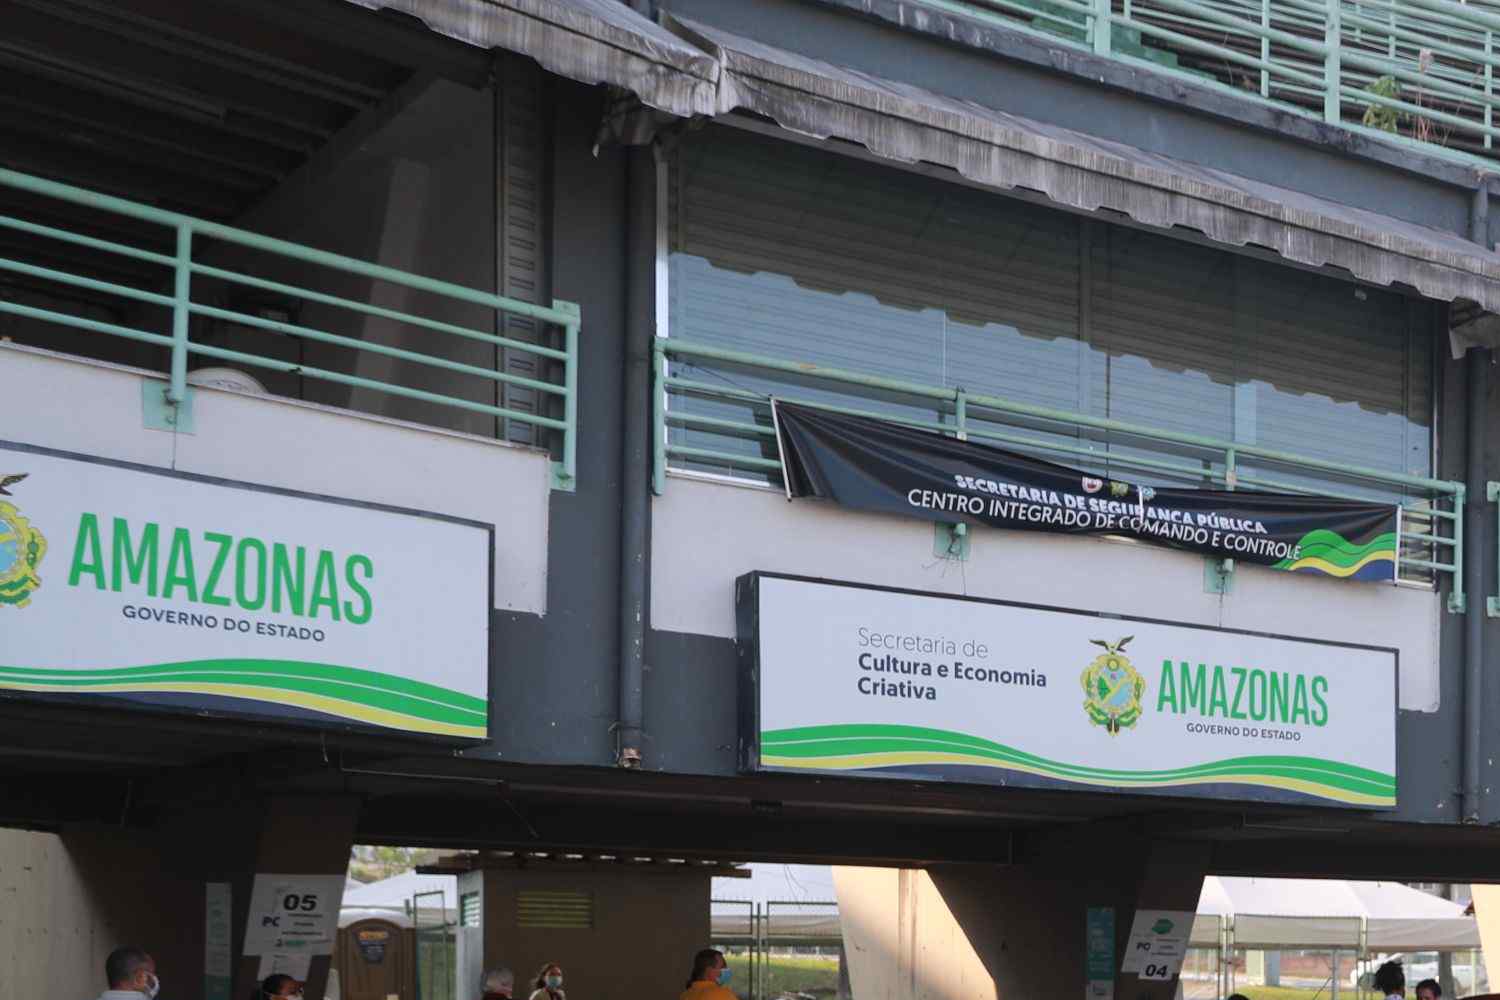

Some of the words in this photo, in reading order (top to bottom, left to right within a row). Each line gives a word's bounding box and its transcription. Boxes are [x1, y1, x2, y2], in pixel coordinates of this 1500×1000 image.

[953, 474, 1063, 506] SECRETARIA
[1064, 494, 1087, 511] DE
[1196, 511, 1268, 535] PÚBLICA
[908, 488, 985, 515] CENTRO
[988, 499, 1091, 528] INTEGRADO
[1095, 512, 1116, 529] DE
[1119, 515, 1209, 545] COMANDO
[1211, 531, 1221, 548] E
[1223, 536, 1302, 561] CONTROLE
[67, 511, 374, 625] AMAZONAS
[122, 604, 218, 629] GOVERNO
[223, 617, 251, 634] DO
[255, 622, 326, 642] ESTADO
[858, 626, 956, 656] Secretaria
[962, 640, 988, 659] de
[858, 652, 932, 677] Cultura
[936, 664, 949, 678] e
[954, 661, 1047, 688] Economia
[857, 676, 937, 701] Criativa
[1156, 659, 1329, 727] AMAZONAS
[1186, 722, 1240, 736] GOVERNO
[1242, 729, 1258, 738] DO
[1261, 729, 1301, 742] ESTADO
[283, 893, 318, 912] 05
[261, 915, 281, 928] PC
[1145, 964, 1168, 978] 04
